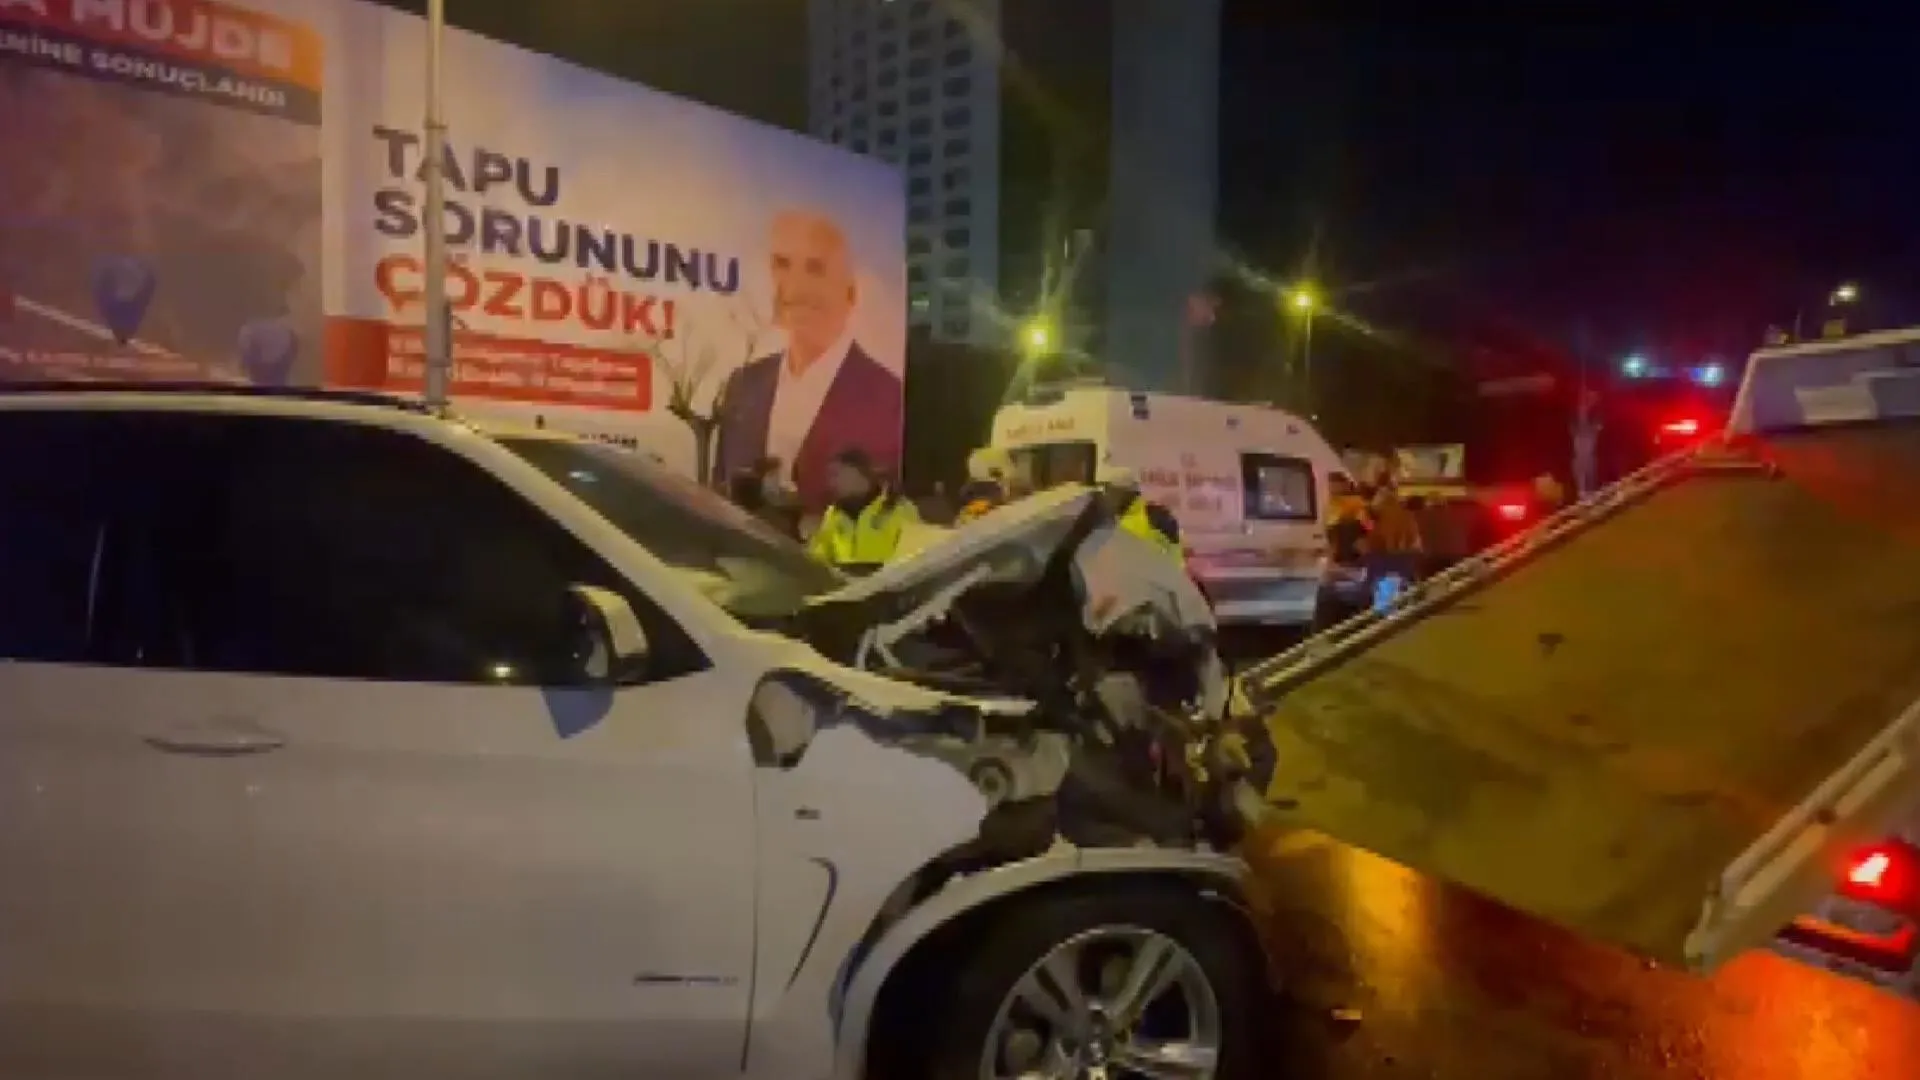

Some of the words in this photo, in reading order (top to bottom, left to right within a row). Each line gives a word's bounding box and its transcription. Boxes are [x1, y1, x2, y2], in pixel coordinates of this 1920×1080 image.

[373, 125, 559, 206] TAPU
[374, 188, 740, 295] SORUNUNU
[374, 252, 675, 339] ÇÖZDÜK!
